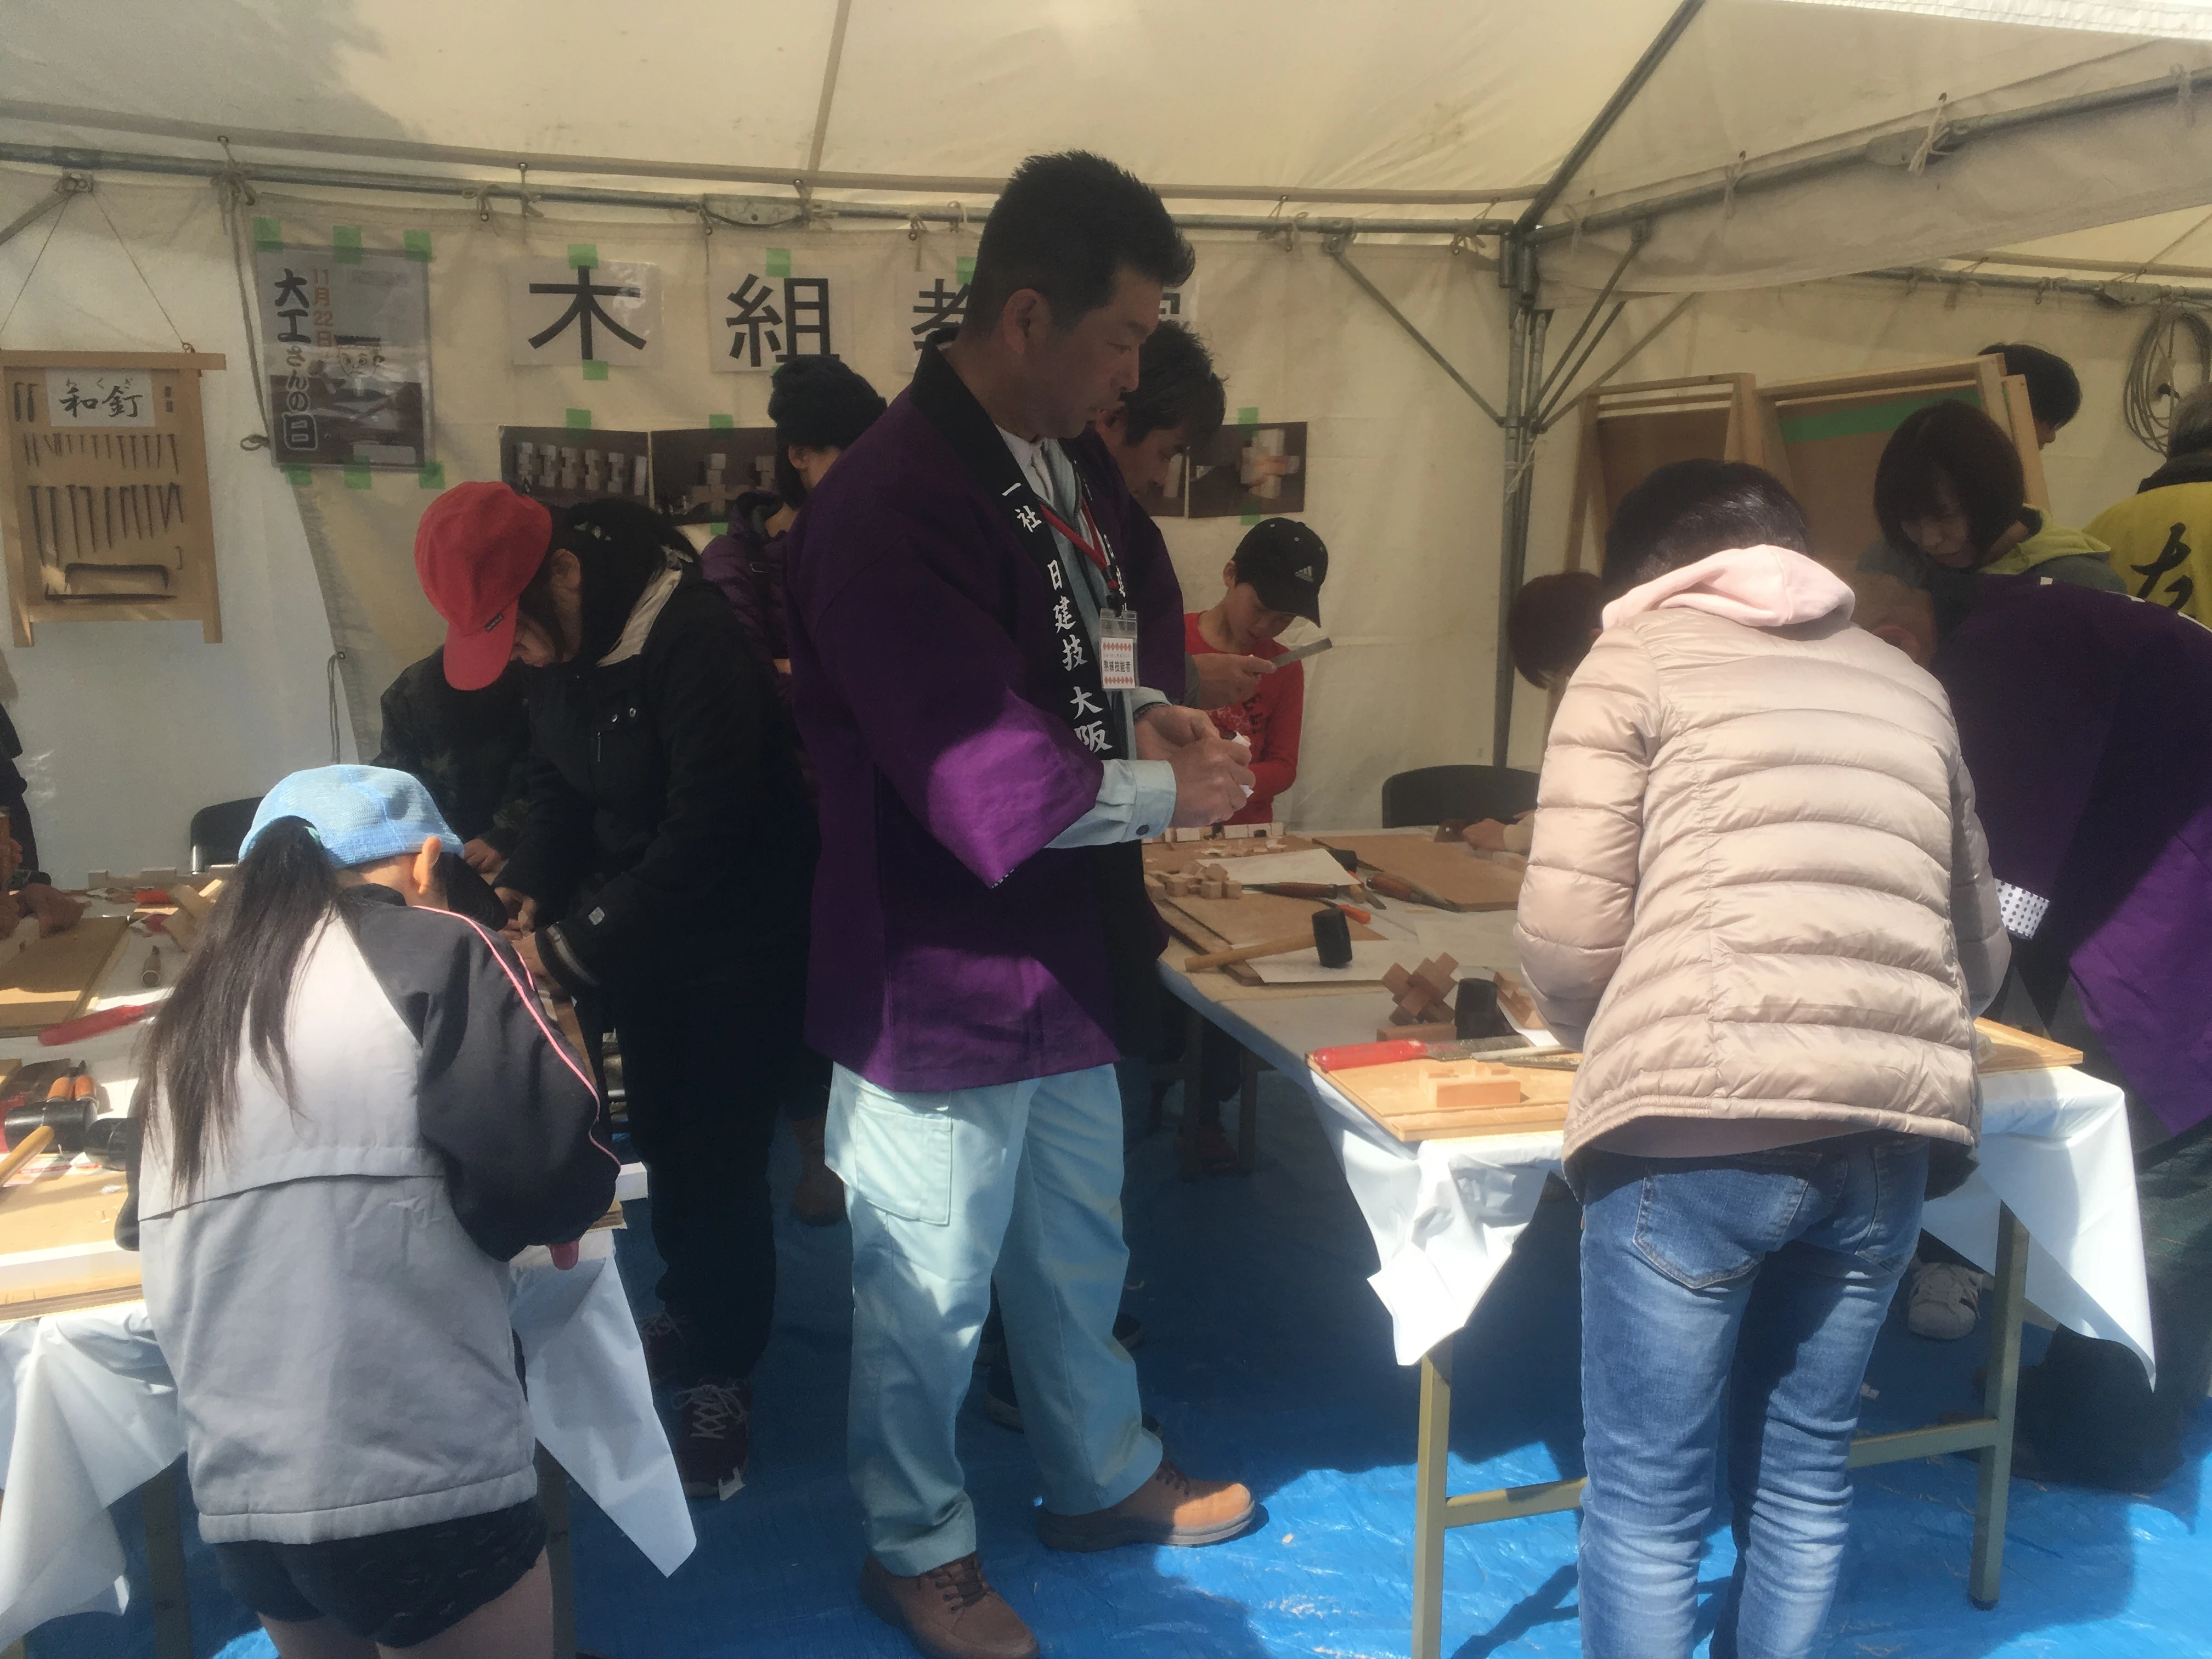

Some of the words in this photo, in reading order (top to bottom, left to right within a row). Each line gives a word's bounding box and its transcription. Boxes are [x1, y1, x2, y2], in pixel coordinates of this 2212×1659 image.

[313, 267, 334, 348] 11月22日
[274, 268, 319, 450] 大工さんの日
[59, 385, 143, 418] 和釘
[1070, 686, 1113, 753] 大阪
